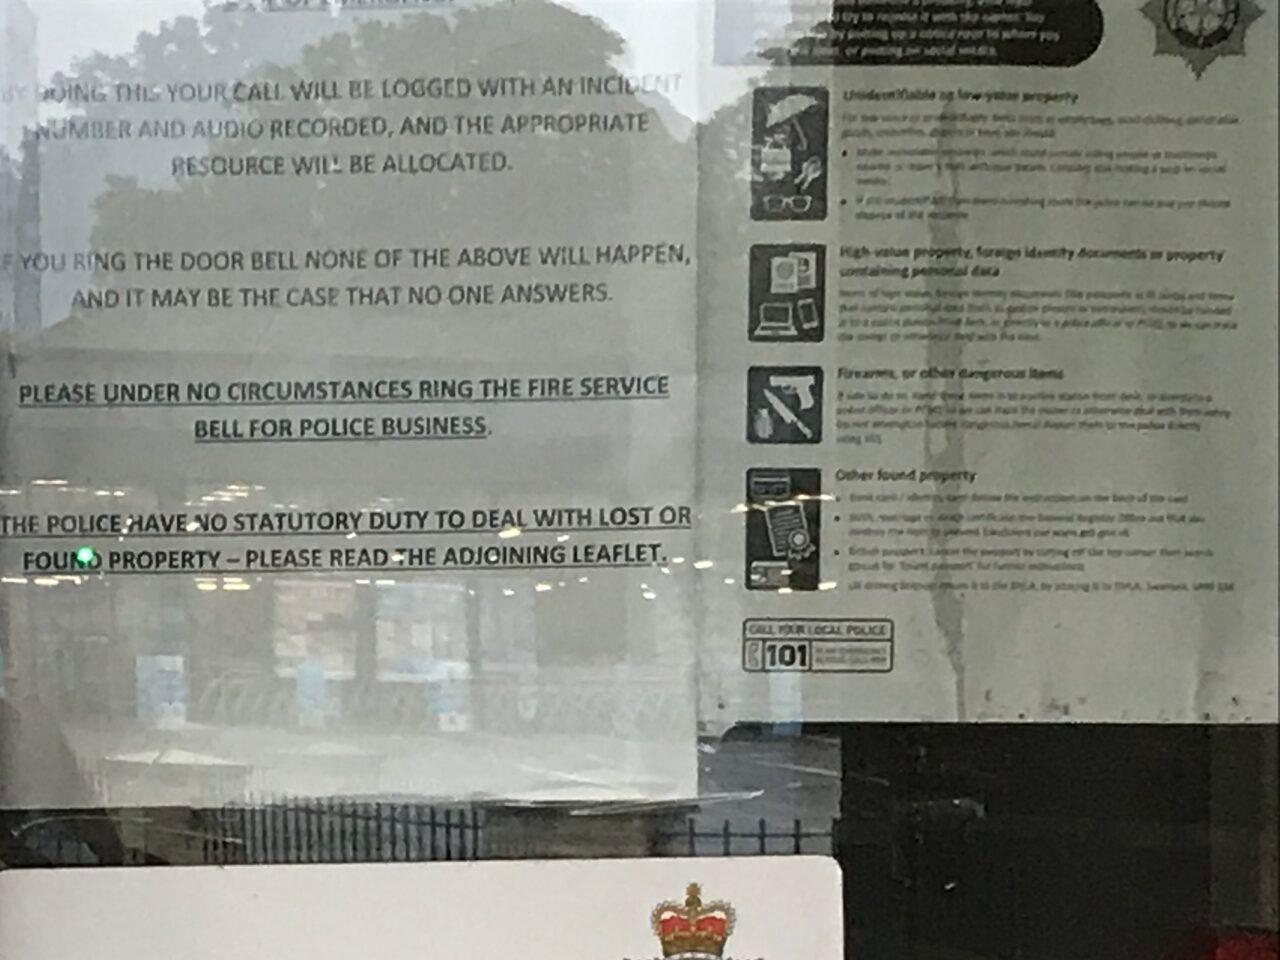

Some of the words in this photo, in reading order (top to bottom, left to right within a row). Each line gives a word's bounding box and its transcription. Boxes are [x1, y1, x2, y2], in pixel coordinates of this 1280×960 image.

[21, 252, 66, 271] YOU
[74, 250, 126, 272] RING
[134, 251, 173, 271] THE
[180, 250, 244, 271] DOOR
[251, 250, 298, 271] BELL
[305, 248, 366, 270] NONE
[374, 248, 402, 268] OF
[409, 247, 450, 268] THE
[457, 246, 530, 267] ABOVE
[538, 245, 590, 267] WILL
[596, 241, 690, 266] HAPPEN,
[71, 289, 119, 310] AND
[126, 288, 144, 307] IT
[151, 287, 200, 307] MAY
[207, 287, 232, 307] BE
[239, 287, 279, 307] THE
[286, 287, 338, 307] CASE
[345, 285, 401, 306] THAT
[408, 284, 442, 306] NO
[448, 284, 493, 305] ONE
[500, 282, 611, 304] ANSWERS.
[19, 383, 95, 405] PLEASE
[103, 382, 180, 404] UNDER
[187, 382, 220, 401] NO
[227, 379, 412, 402] CIRCUMSTANCES
[419, 379, 473, 400] RING
[479, 378, 520, 400] THE
[528, 377, 573, 399] FIRE
[580, 375, 668, 399] SERVICE
[195, 419, 243, 441] BELL
[249, 418, 292, 440] FOR
[300, 417, 374, 440] POLICE
[378, 416, 491, 440] BUSINESS.
[0, 514, 39, 534] THE
[47, 514, 121, 535] POLICE
[128, 512, 189, 534] HAVE
[233, 511, 362, 533] STATUTORY
[369, 510, 428, 530] DUTY
[434, 509, 465, 530] TO
[472, 508, 527, 528] DEAL
[532, 508, 591, 527] WITH
[599, 506, 653, 528] LOST
[659, 505, 690, 527] OR
[108, 549, 220, 572] PROPERTY
[245, 548, 322, 570] PLEASE
[329, 547, 388, 569] READ
[442, 545, 565, 568] ADJOINING
[572, 543, 666, 566] LEAFLET.
[767, 644, 806, 666] 101
